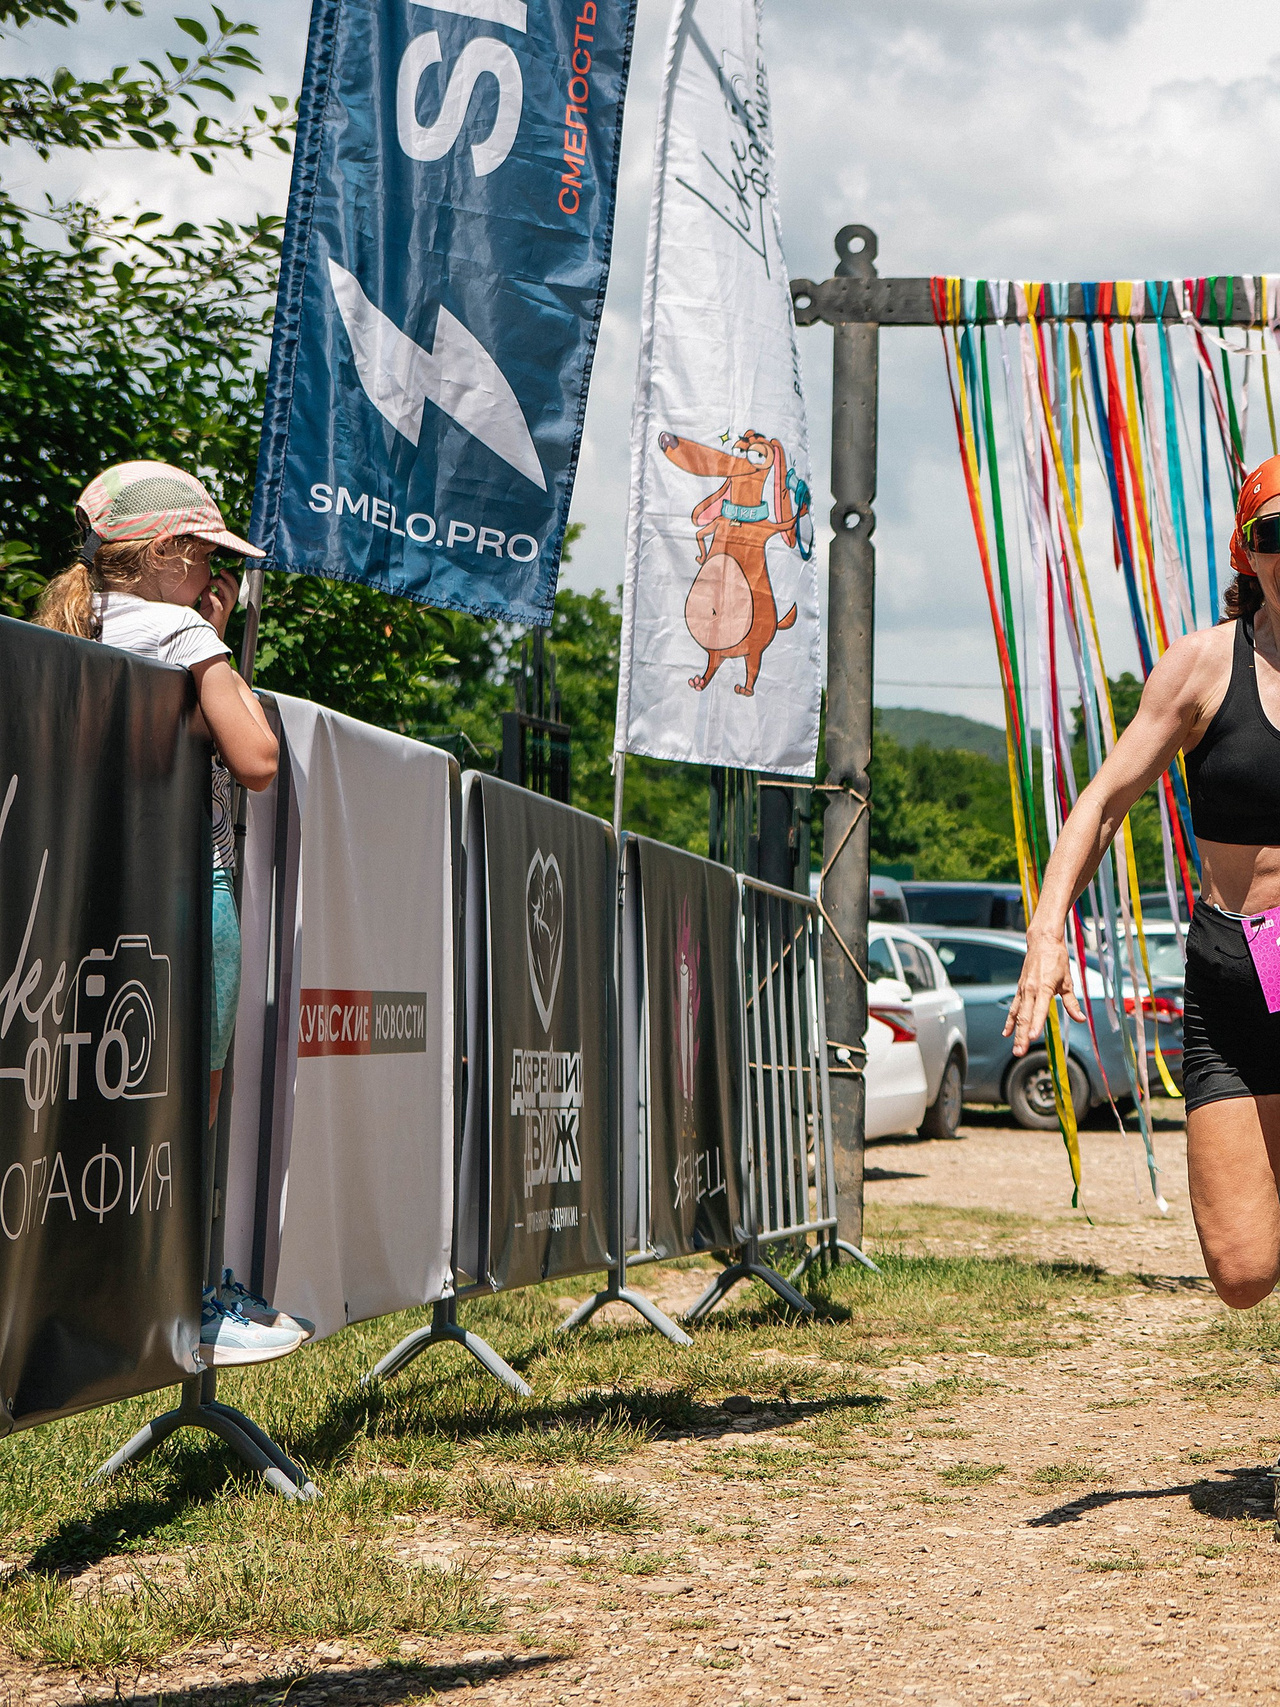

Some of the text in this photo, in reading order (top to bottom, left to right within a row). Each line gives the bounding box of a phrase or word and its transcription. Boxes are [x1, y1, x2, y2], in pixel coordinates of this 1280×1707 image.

[396, 0, 528, 178] S
[557, 1, 597, 215] СМЕЛОСТЬ
[308, 483, 539, 563] SMELO.PRO
[725, 504, 757, 520] LIKE
[375, 1004, 424, 1040] НОВОСТИ
